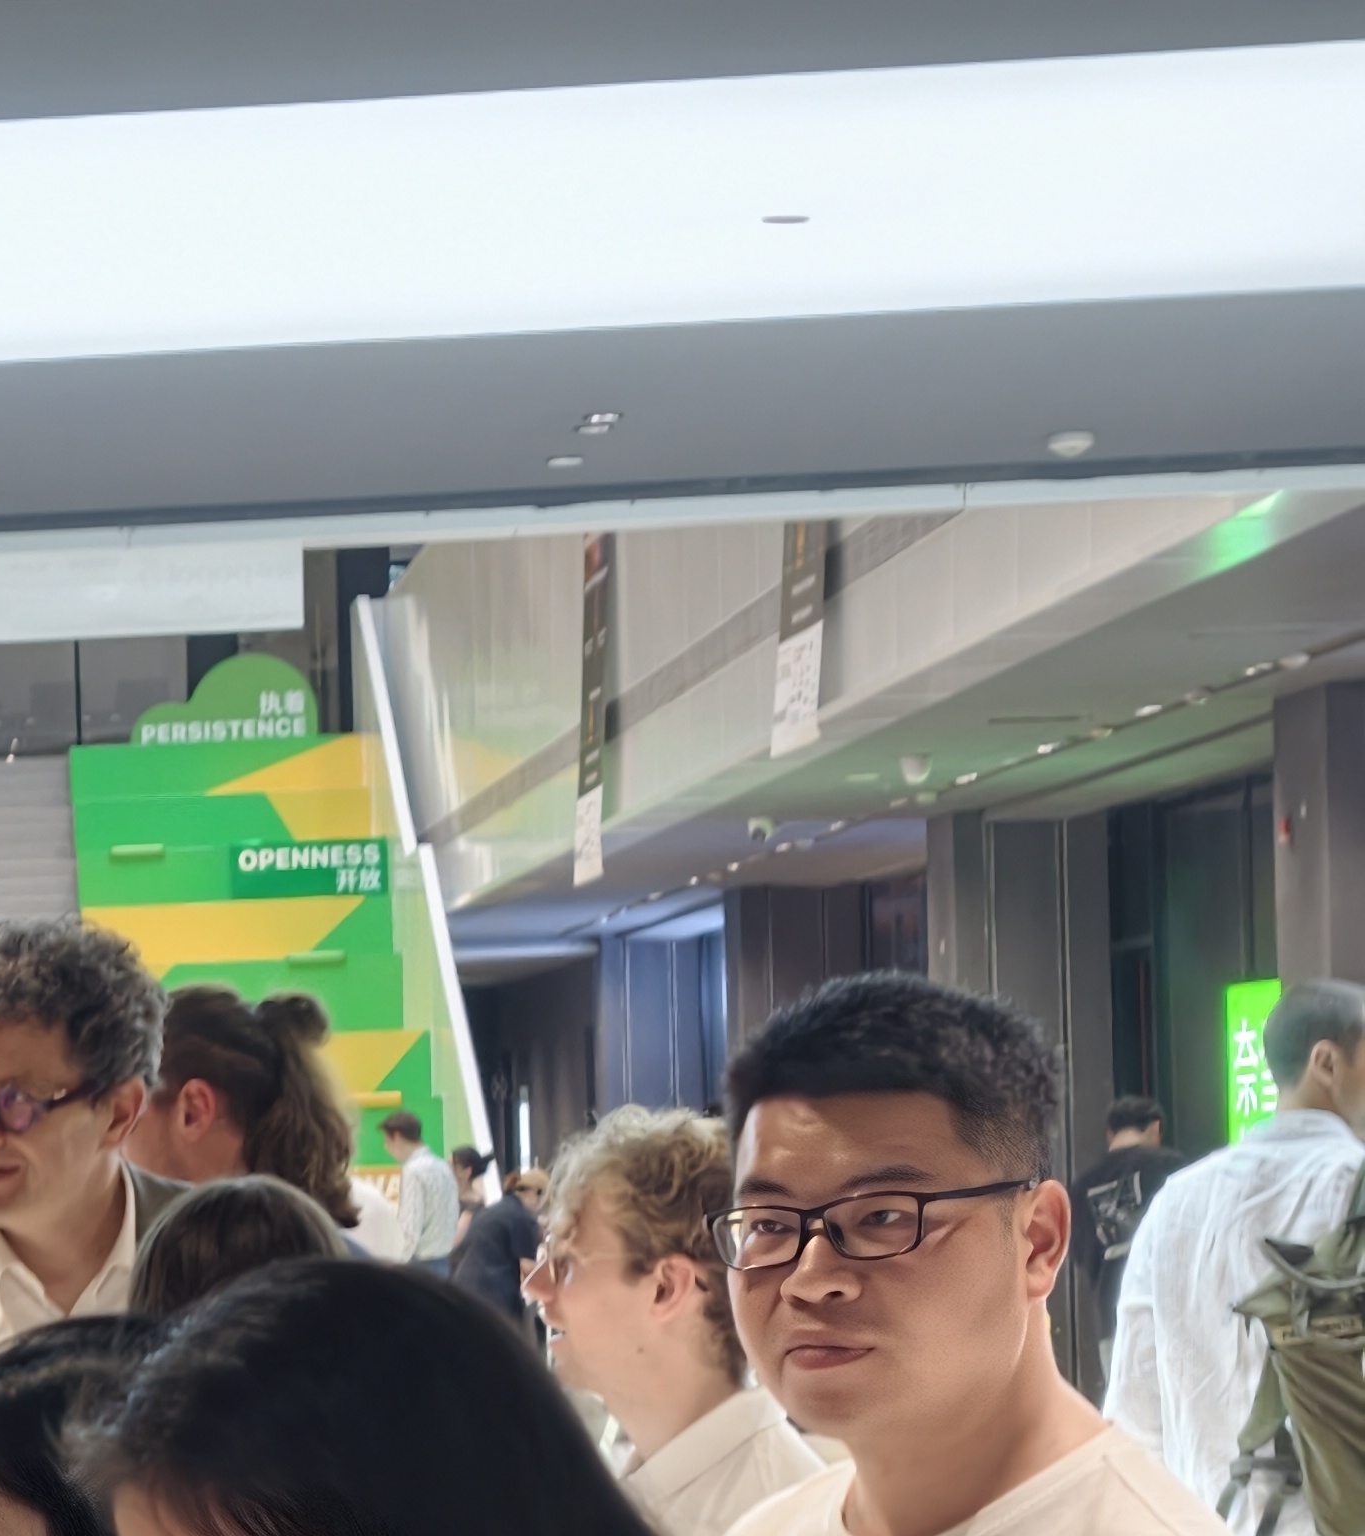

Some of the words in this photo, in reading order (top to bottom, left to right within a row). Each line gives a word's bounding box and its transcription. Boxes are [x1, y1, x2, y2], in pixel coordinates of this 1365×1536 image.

[140, 717, 307, 744] PERSISTENCE
[237, 843, 381, 872] OPENNESS
[336, 867, 381, 894] 开放
